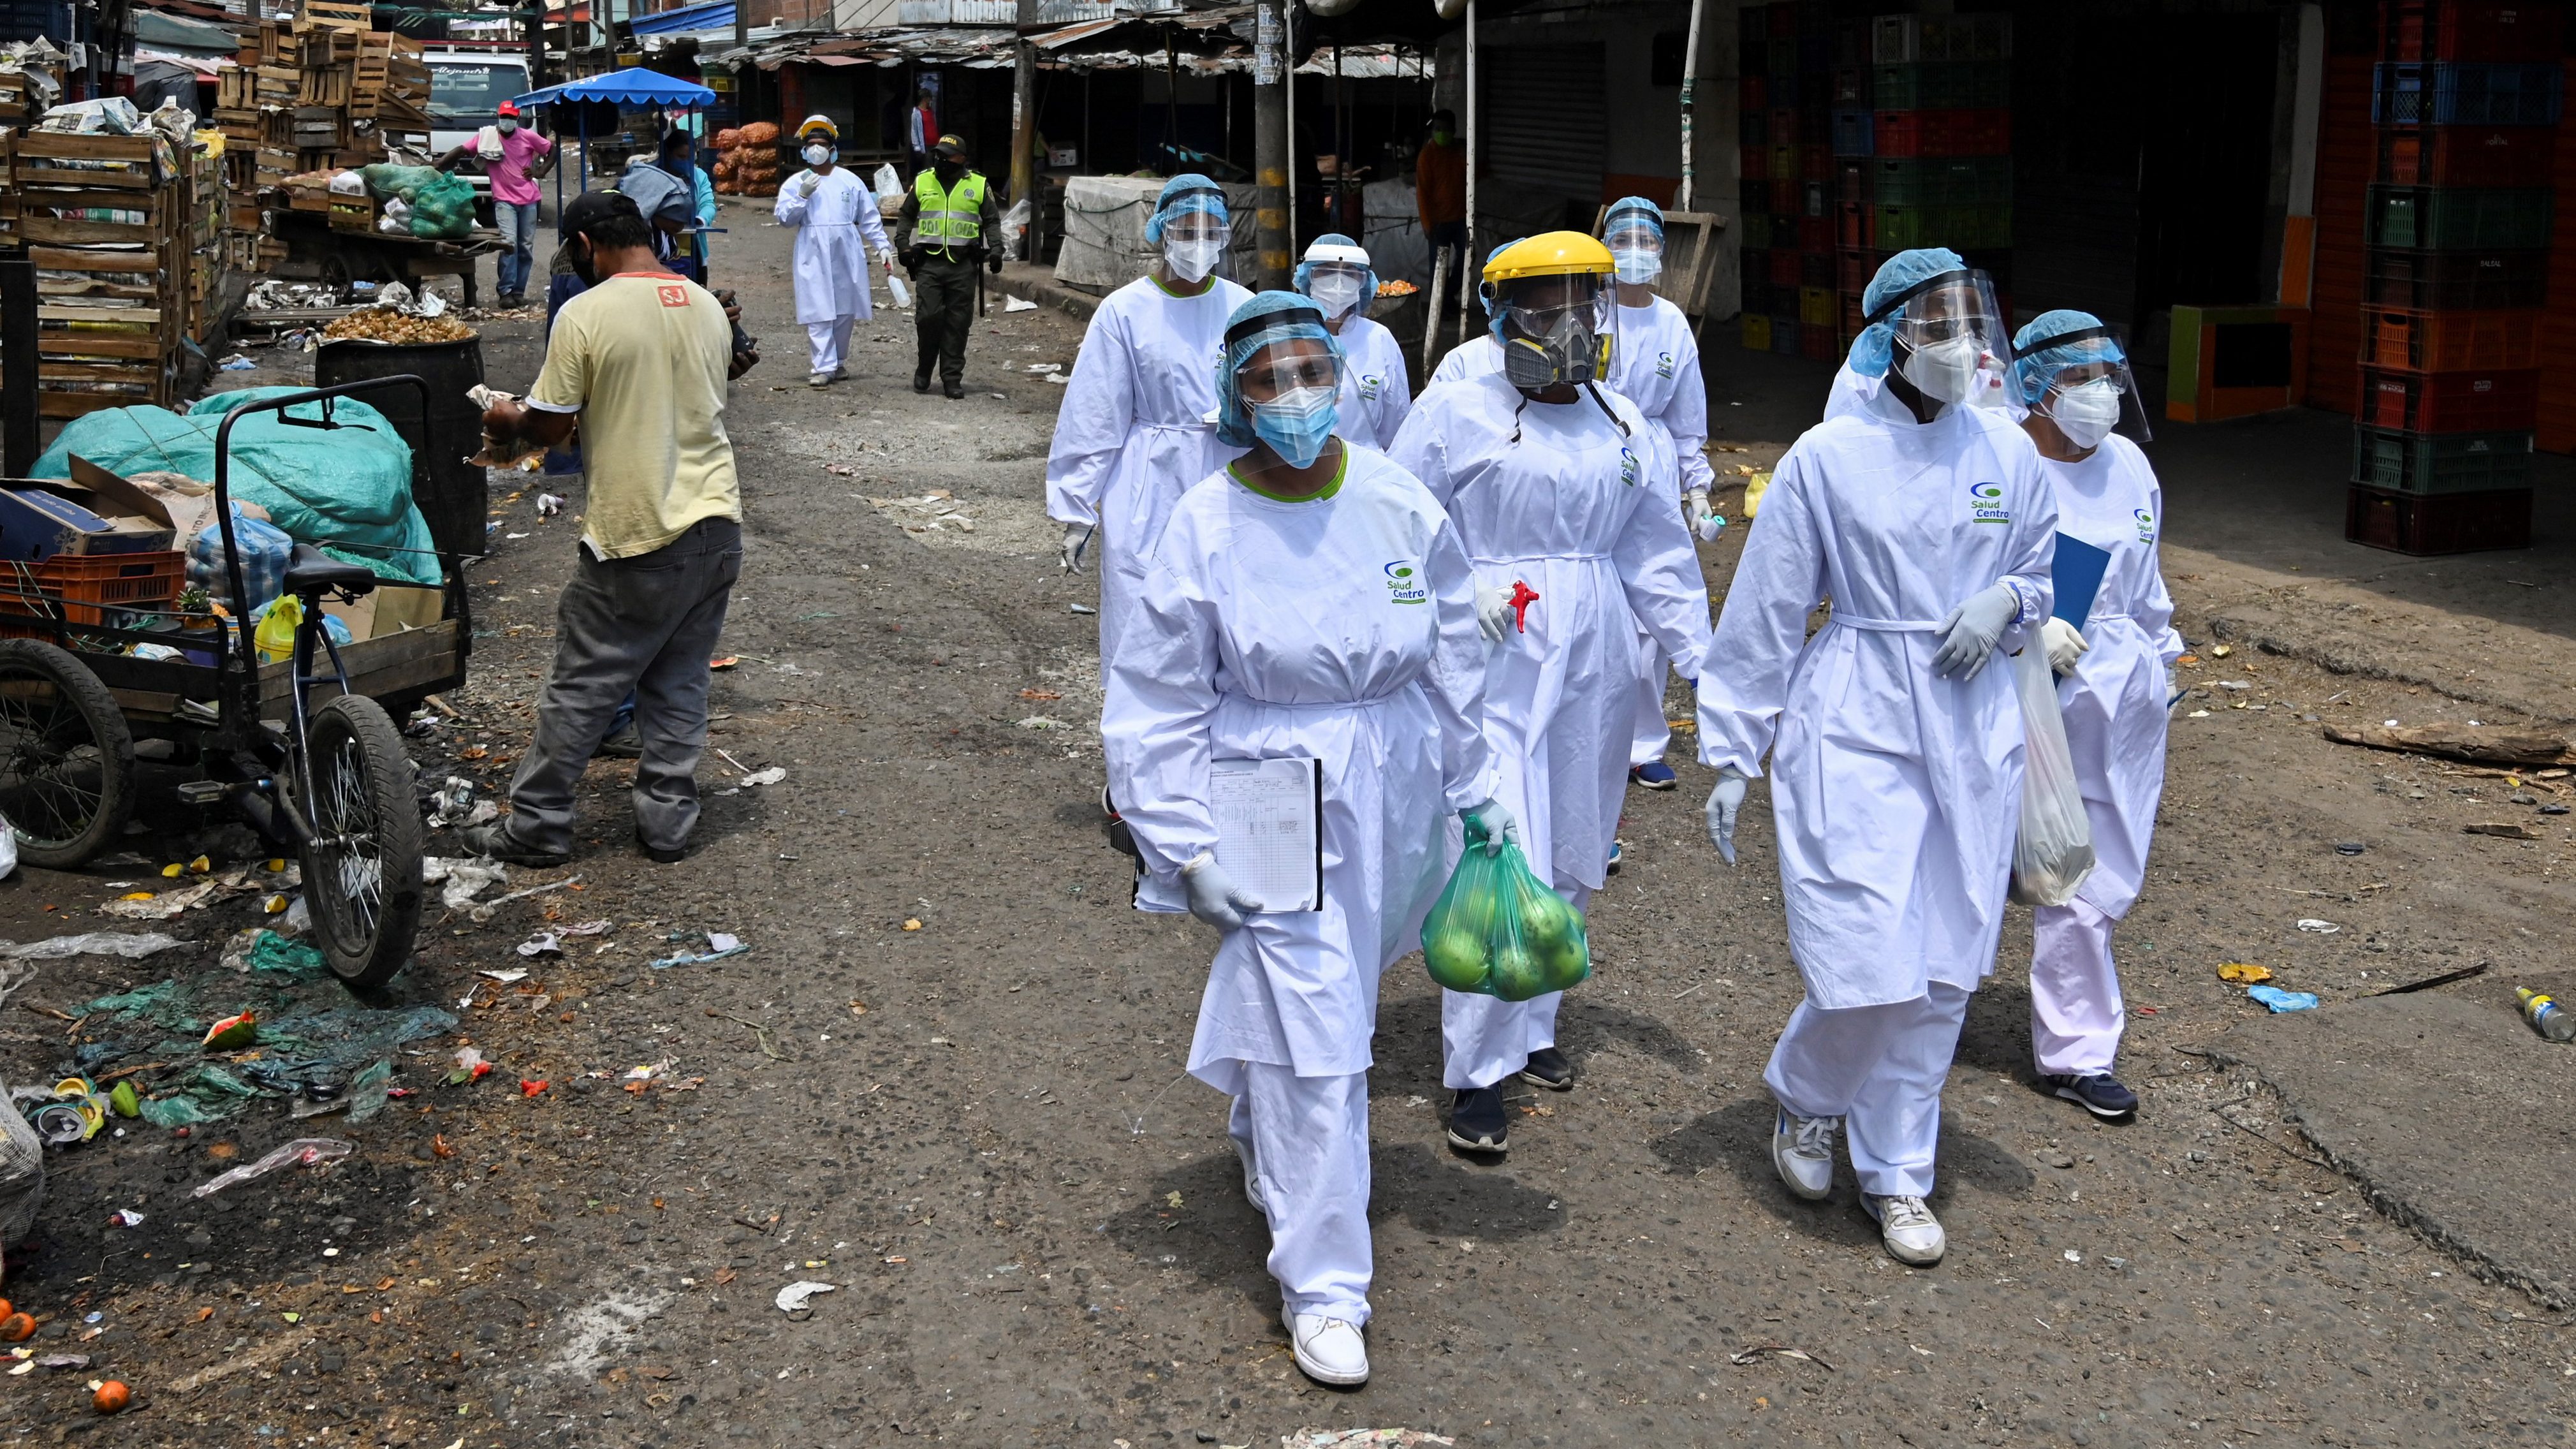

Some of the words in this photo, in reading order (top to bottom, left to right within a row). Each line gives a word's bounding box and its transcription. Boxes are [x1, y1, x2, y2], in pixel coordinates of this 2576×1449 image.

[1976, 509, 2009, 518] Centro
[1387, 580, 1412, 590] Salud
[1393, 589, 1424, 599] Centro
